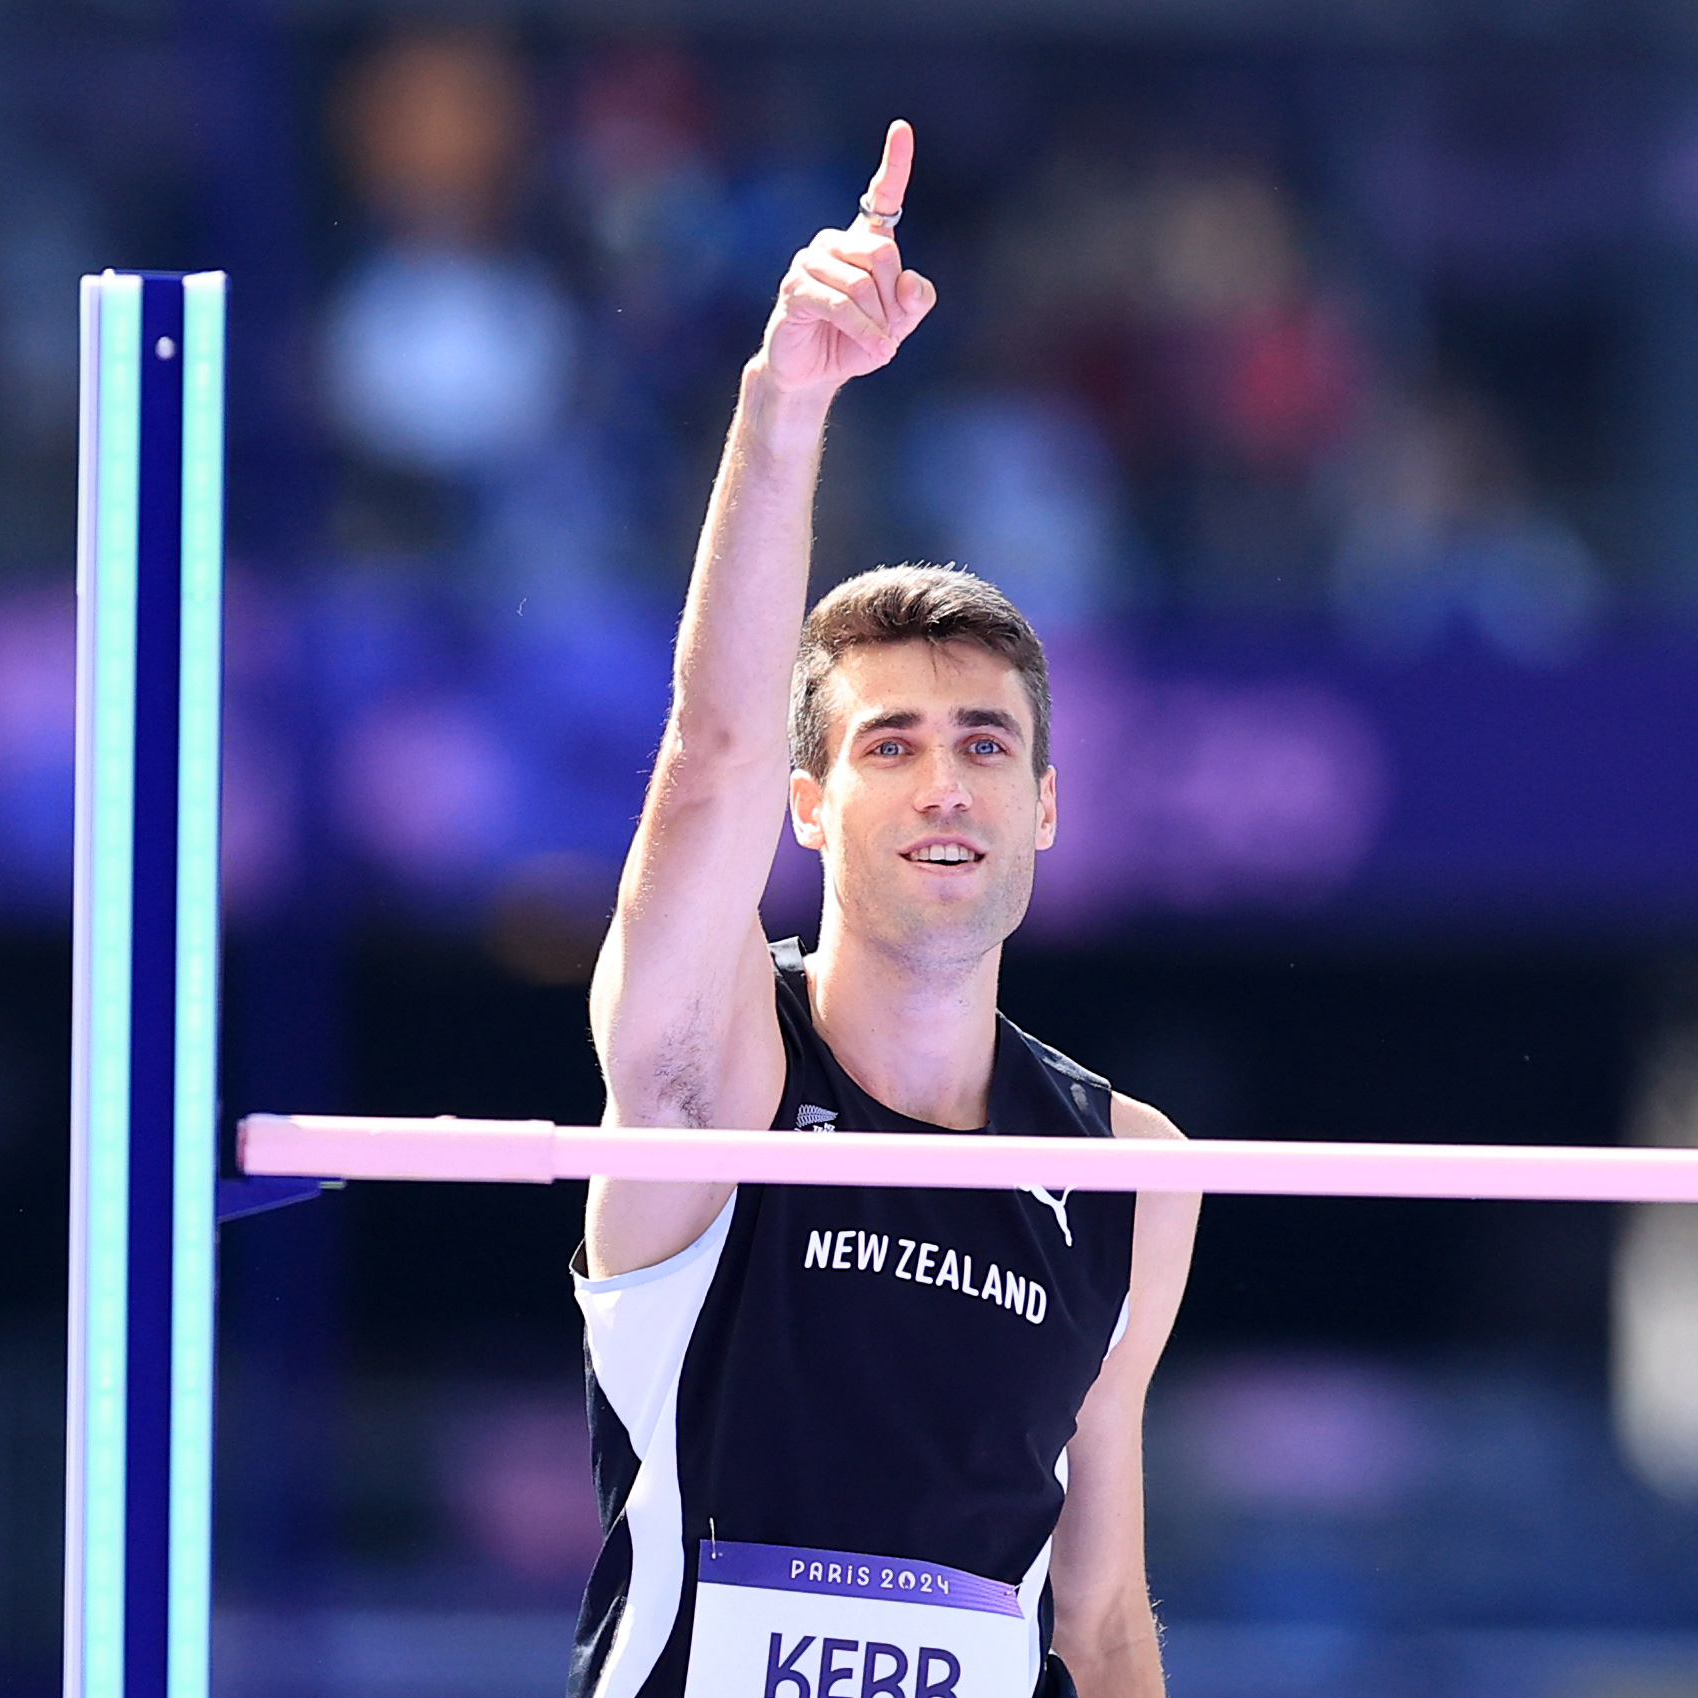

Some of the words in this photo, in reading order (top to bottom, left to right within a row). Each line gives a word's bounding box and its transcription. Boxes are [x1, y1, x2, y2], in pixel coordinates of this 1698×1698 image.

[804, 1230, 889, 1272] NEW
[895, 1238, 1047, 1325] ZEALAND
[880, 1569, 949, 1594] 2024
